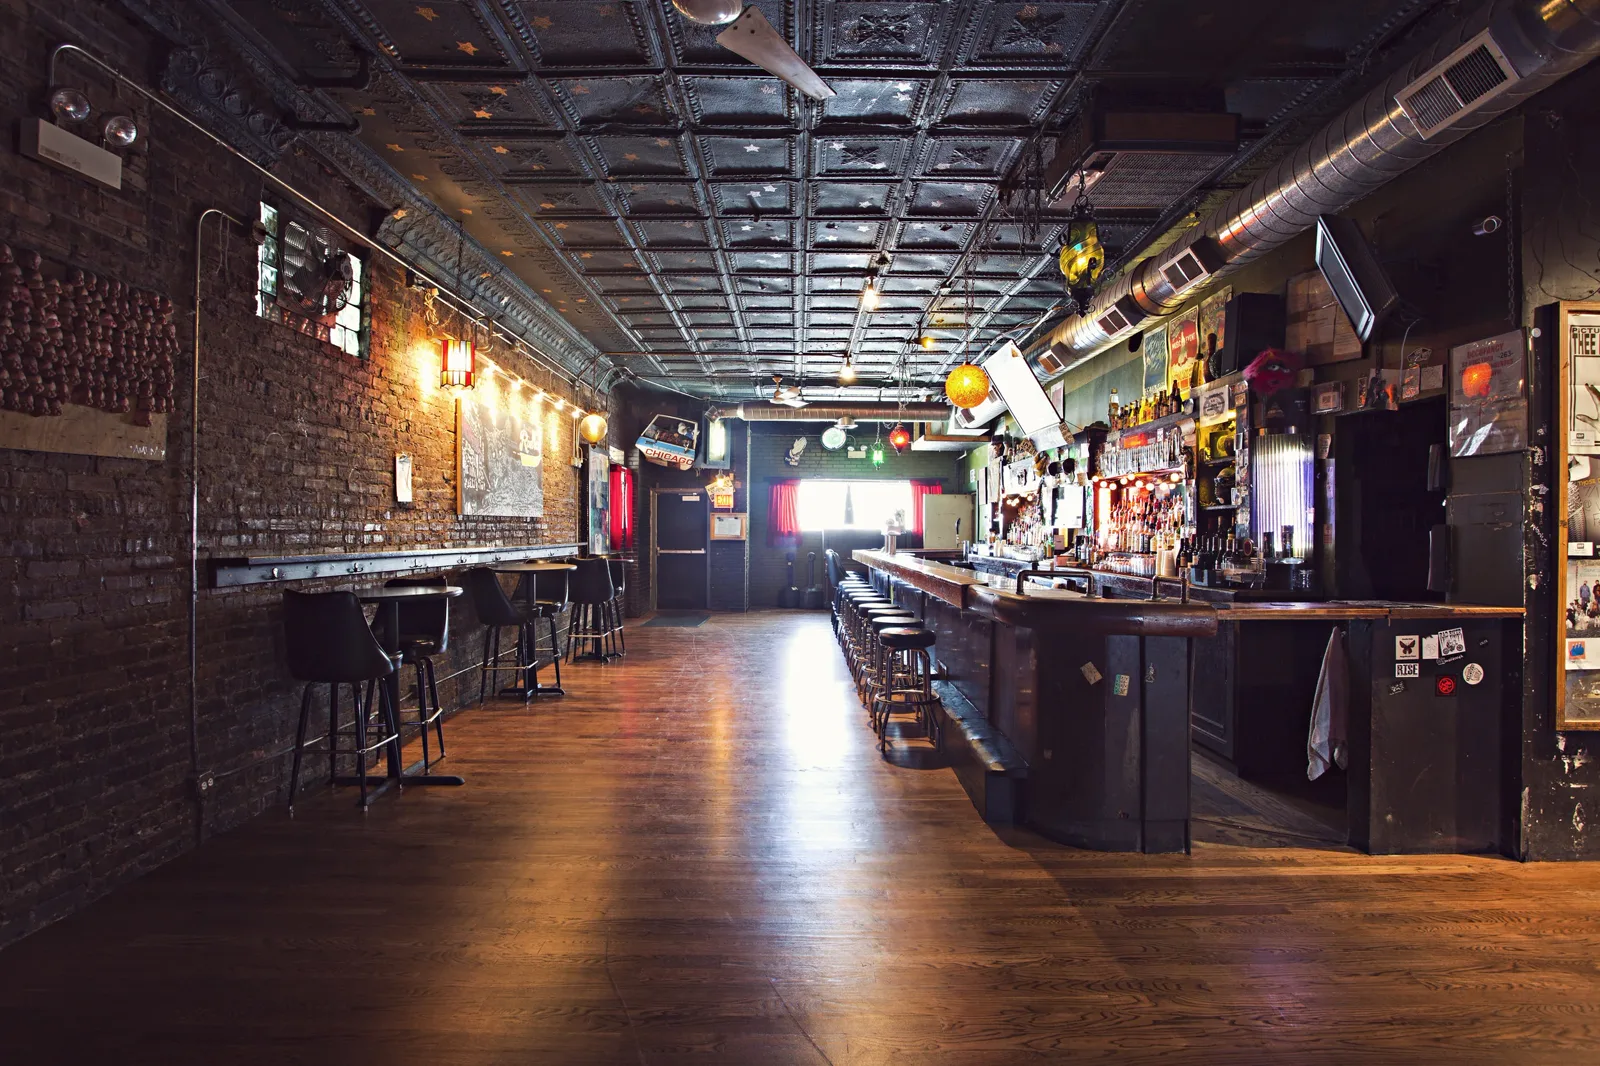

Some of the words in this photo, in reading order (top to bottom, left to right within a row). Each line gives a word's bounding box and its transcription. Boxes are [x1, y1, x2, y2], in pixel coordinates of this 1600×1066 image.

[1572, 333, 1596, 355] THEE
[645, 448, 694, 465] CHICAGO
[716, 494, 731, 504] EXIT
[1397, 664, 1418, 676] RISE
